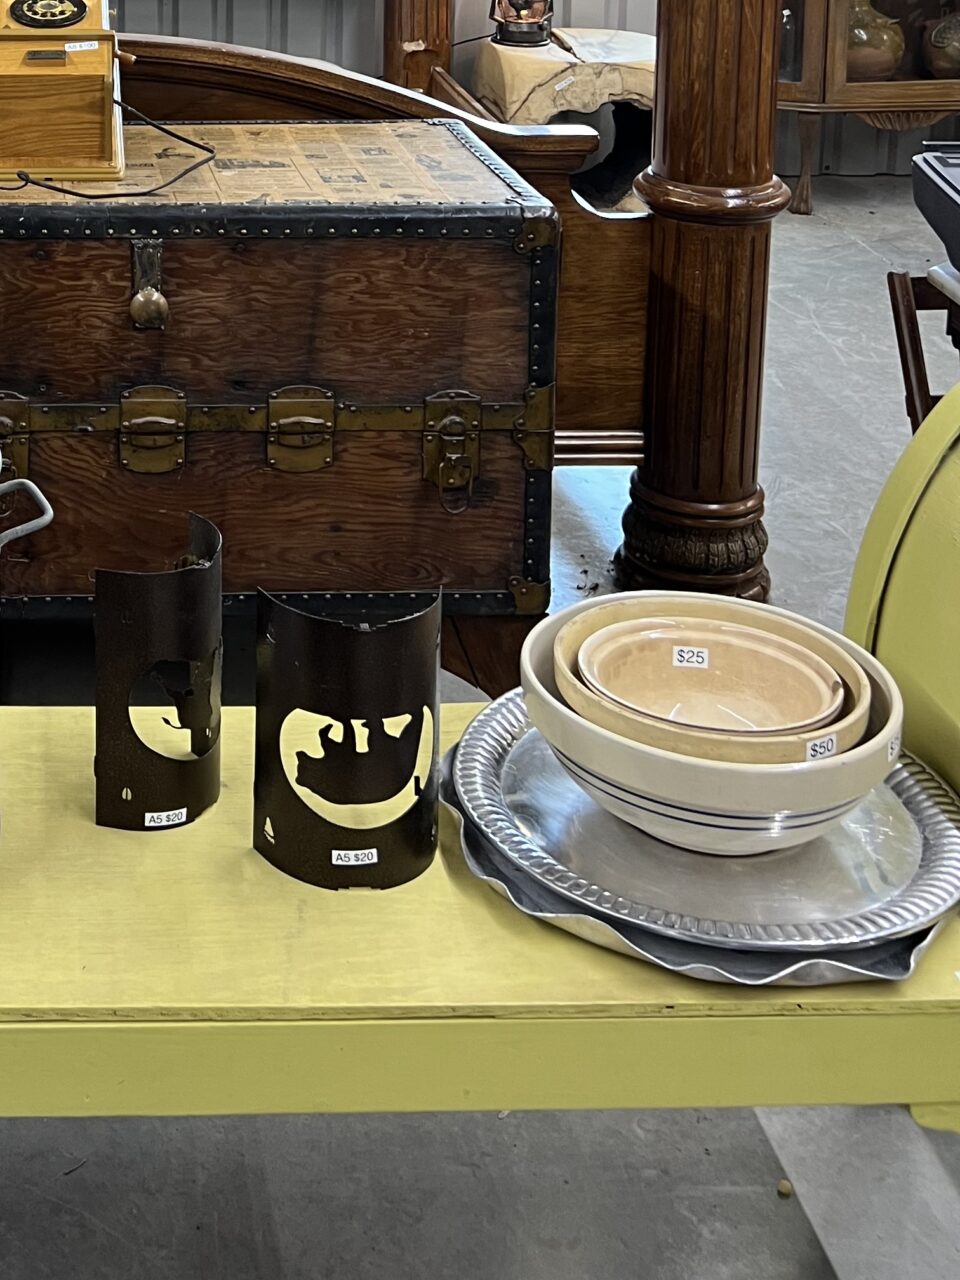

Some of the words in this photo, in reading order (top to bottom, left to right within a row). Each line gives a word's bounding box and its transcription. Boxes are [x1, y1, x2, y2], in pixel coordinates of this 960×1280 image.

[677, 649, 705, 665] $25
[810, 737, 834, 758] $50
[148, 814, 163, 825] A5
[165, 811, 183, 823] $20
[335, 852, 351, 863] A5
[353, 851, 374, 862] $20
